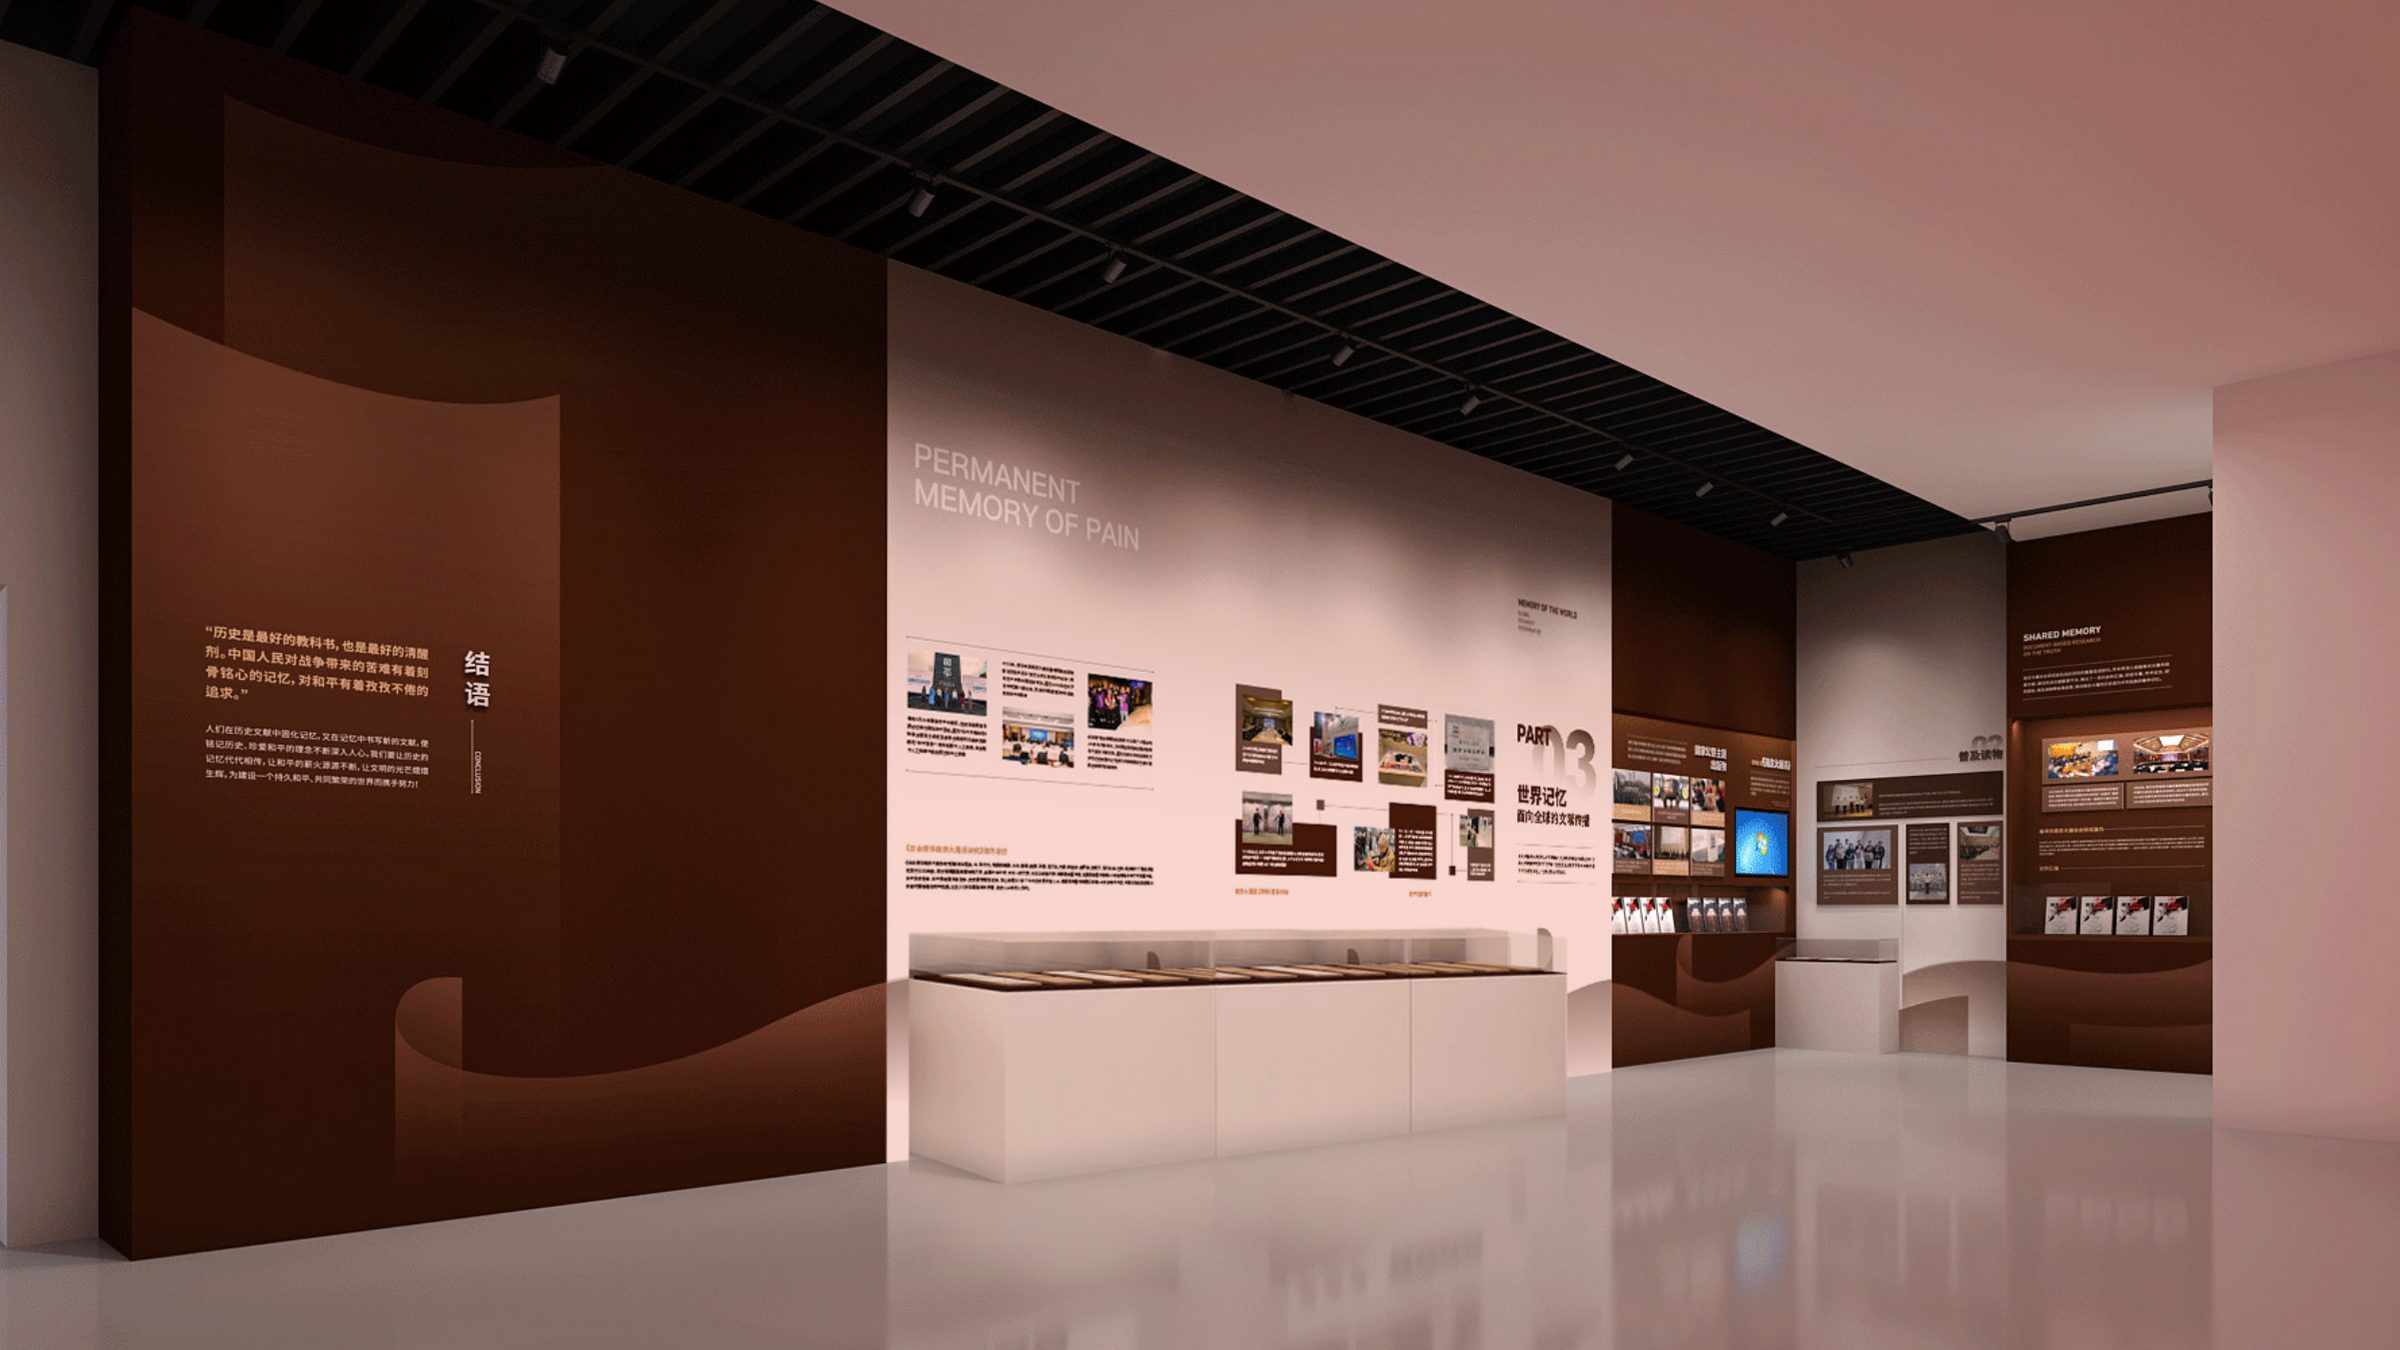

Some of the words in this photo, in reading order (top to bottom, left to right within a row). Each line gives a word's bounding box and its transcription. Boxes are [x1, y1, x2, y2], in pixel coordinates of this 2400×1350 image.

[914, 442, 1080, 504] PERMANENT
[914, 478, 1039, 529] MEMORY
[1045, 508, 1079, 537] OF
[1086, 516, 1139, 551] PAIN
[1518, 598, 1540, 611] MEMORY
[1549, 605, 1558, 615] THE
[1559, 608, 1577, 620] WORLD
[2023, 630, 2060, 642] SHARED
[2062, 625, 2102, 638] MEMORY
[464, 650, 491, 709] 结语
[1517, 724, 1552, 747] PART
[474, 751, 483, 795] CONCLUSION
[1517, 784, 1567, 807] 世界记忆
